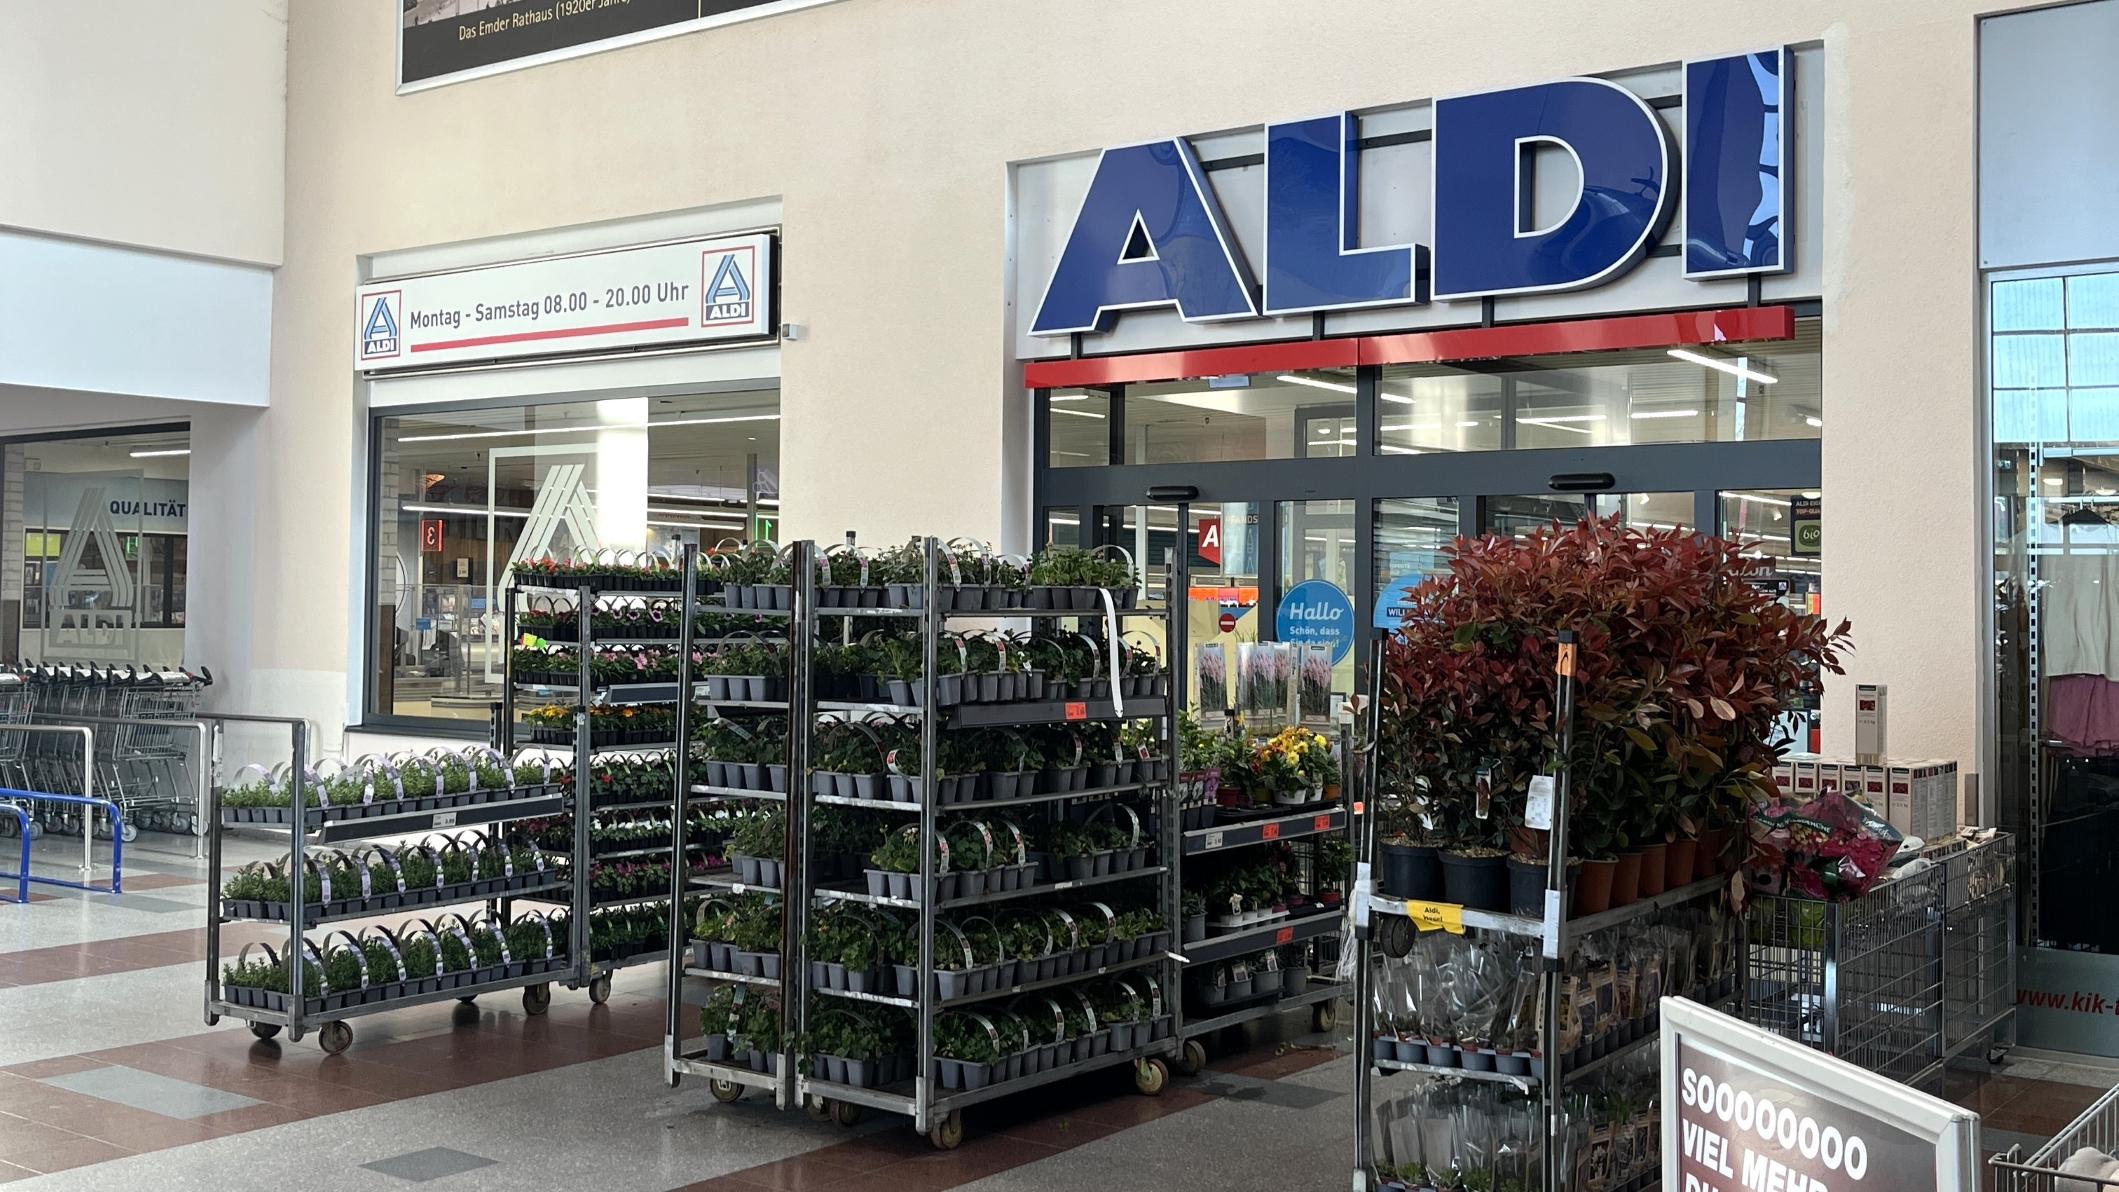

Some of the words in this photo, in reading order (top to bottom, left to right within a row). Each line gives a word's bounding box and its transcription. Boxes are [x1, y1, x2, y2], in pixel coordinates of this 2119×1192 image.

[459, 25, 476, 41] Das
[479, 18, 510, 36] Emder
[512, 8, 553, 29] Rathaus
[1027, 45, 1794, 337] ALDI
[410, 310, 461, 330] Montag
[475, 300, 539, 322] Samstag
[544, 291, 588, 315] 08.00
[605, 284, 651, 308] 20.00
[657, 281, 689, 302] Uhr
[709, 302, 746, 320] ALDI
[366, 338, 395, 353] ALDI
[110, 500, 187, 517] QUALITÄT
[1290, 602, 1344, 620] Hallo
[1290, 625, 1318, 636] Schön,
[1320, 626, 1340, 635] dass
[1682, 1067, 1868, 1181] SOOOOOOOO
[1682, 1118, 1734, 1179] VIEL
